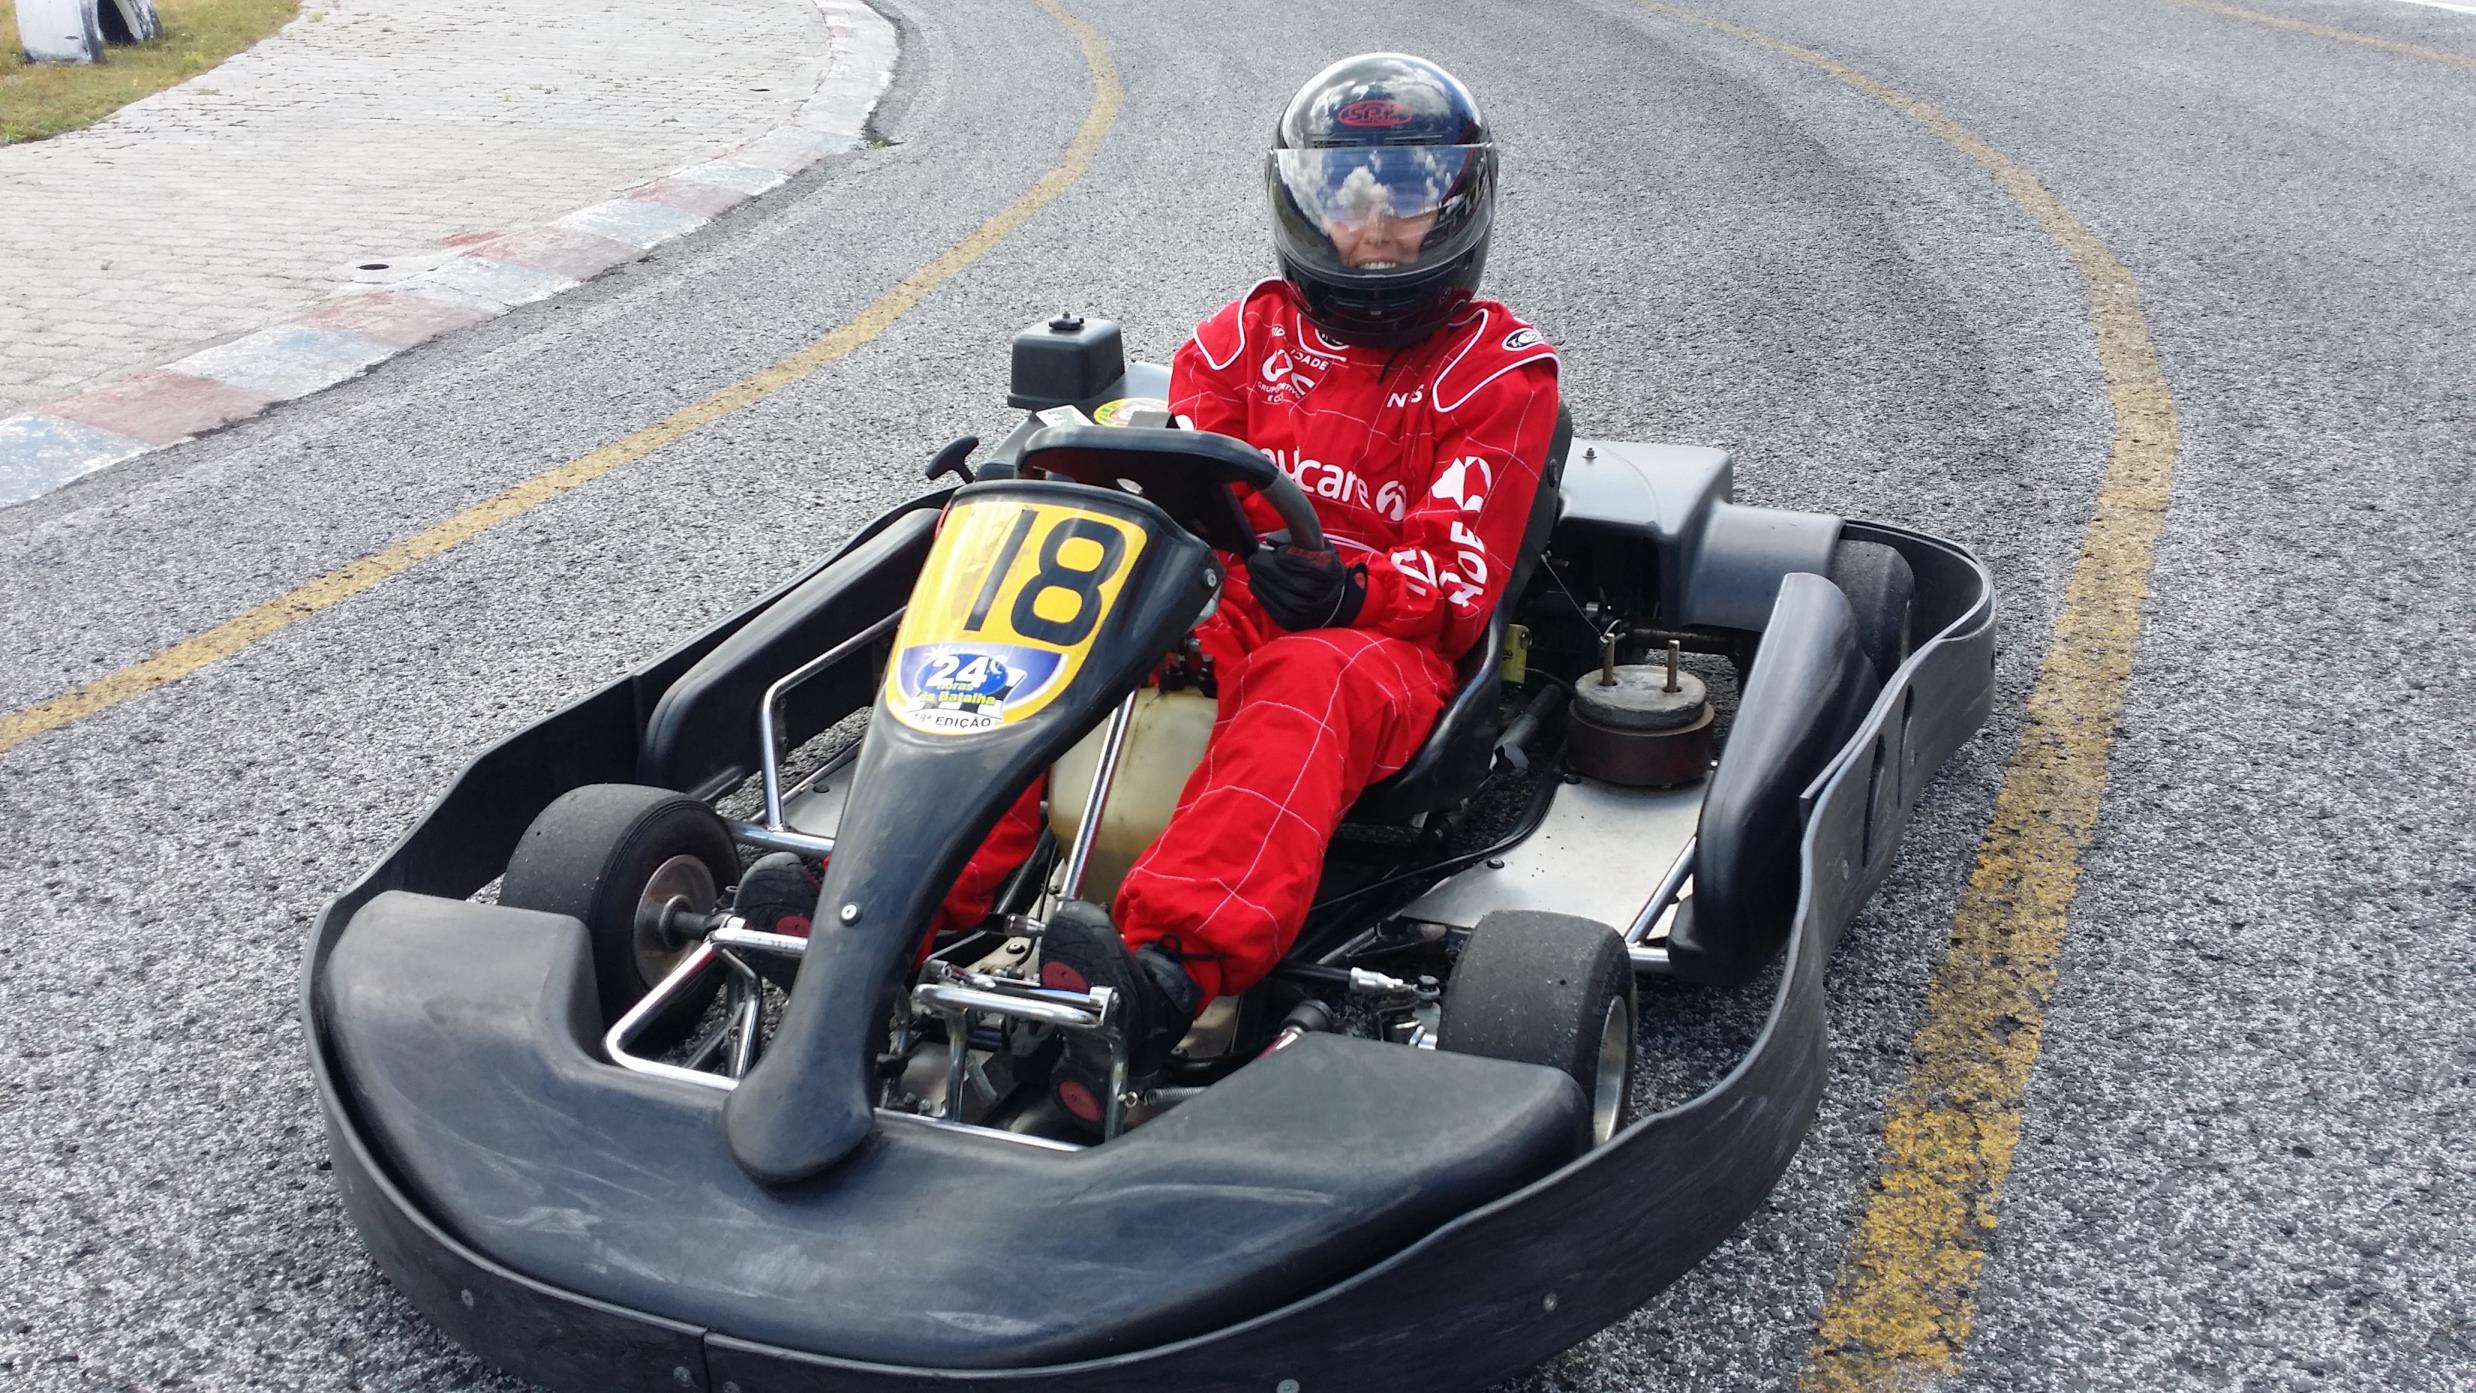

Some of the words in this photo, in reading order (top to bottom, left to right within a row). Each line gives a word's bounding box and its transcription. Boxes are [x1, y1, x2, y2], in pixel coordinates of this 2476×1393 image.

[963, 508, 1128, 647] 18
[925, 655, 989, 689] 24
[938, 690, 997, 706] Batalha
[935, 715, 992, 729] EDIÇÃO
